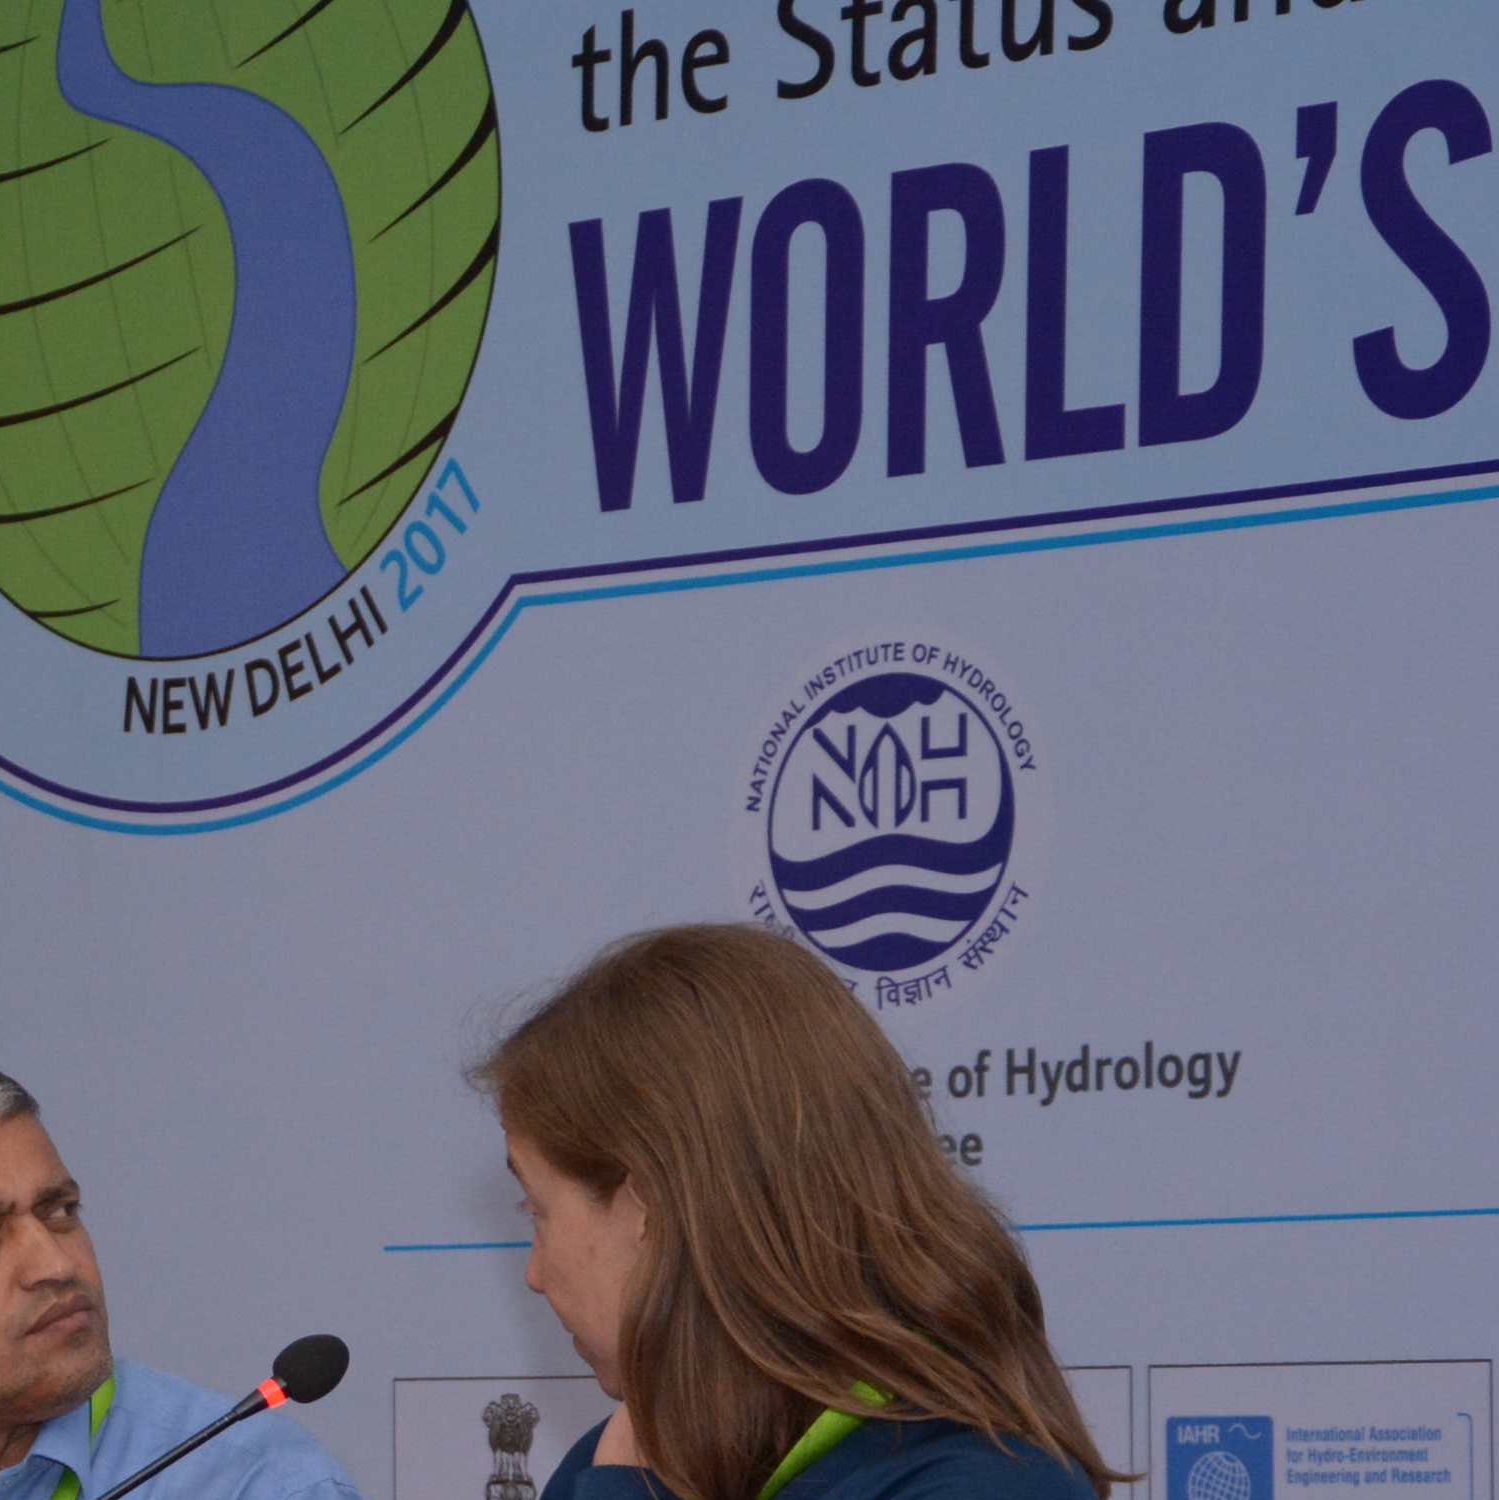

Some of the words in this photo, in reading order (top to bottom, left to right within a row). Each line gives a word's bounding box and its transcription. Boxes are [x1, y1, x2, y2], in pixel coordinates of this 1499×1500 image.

[571, 8, 731, 133] the
[776, 0, 1114, 101] Status
[568, 78, 1494, 513] WORLD'S
[123, 667, 236, 735] NEW
[245, 585, 389, 717] DELHI
[379, 458, 481, 612] 2017
[746, 699, 806, 812] NATIONAL
[803, 642, 905, 700] INSTITUTE
[912, 644, 941, 665] OF
[943, 652, 1037, 773] HYDROLOGY
[948, 1049, 992, 1099] of
[1005, 1040, 1243, 1107] Hydrology
[1177, 1424, 1220, 1444] IAHR
[1286, 1426, 1365, 1443] International
[1369, 1426, 1442, 1442] Association
[1286, 1447, 1304, 1463] for
[1307, 1447, 1429, 1466] Hydro-Environment
[1286, 1468, 1360, 1487] Engineering
[1364, 1468, 1387, 1484] and
[1391, 1468, 1451, 1484] Research
